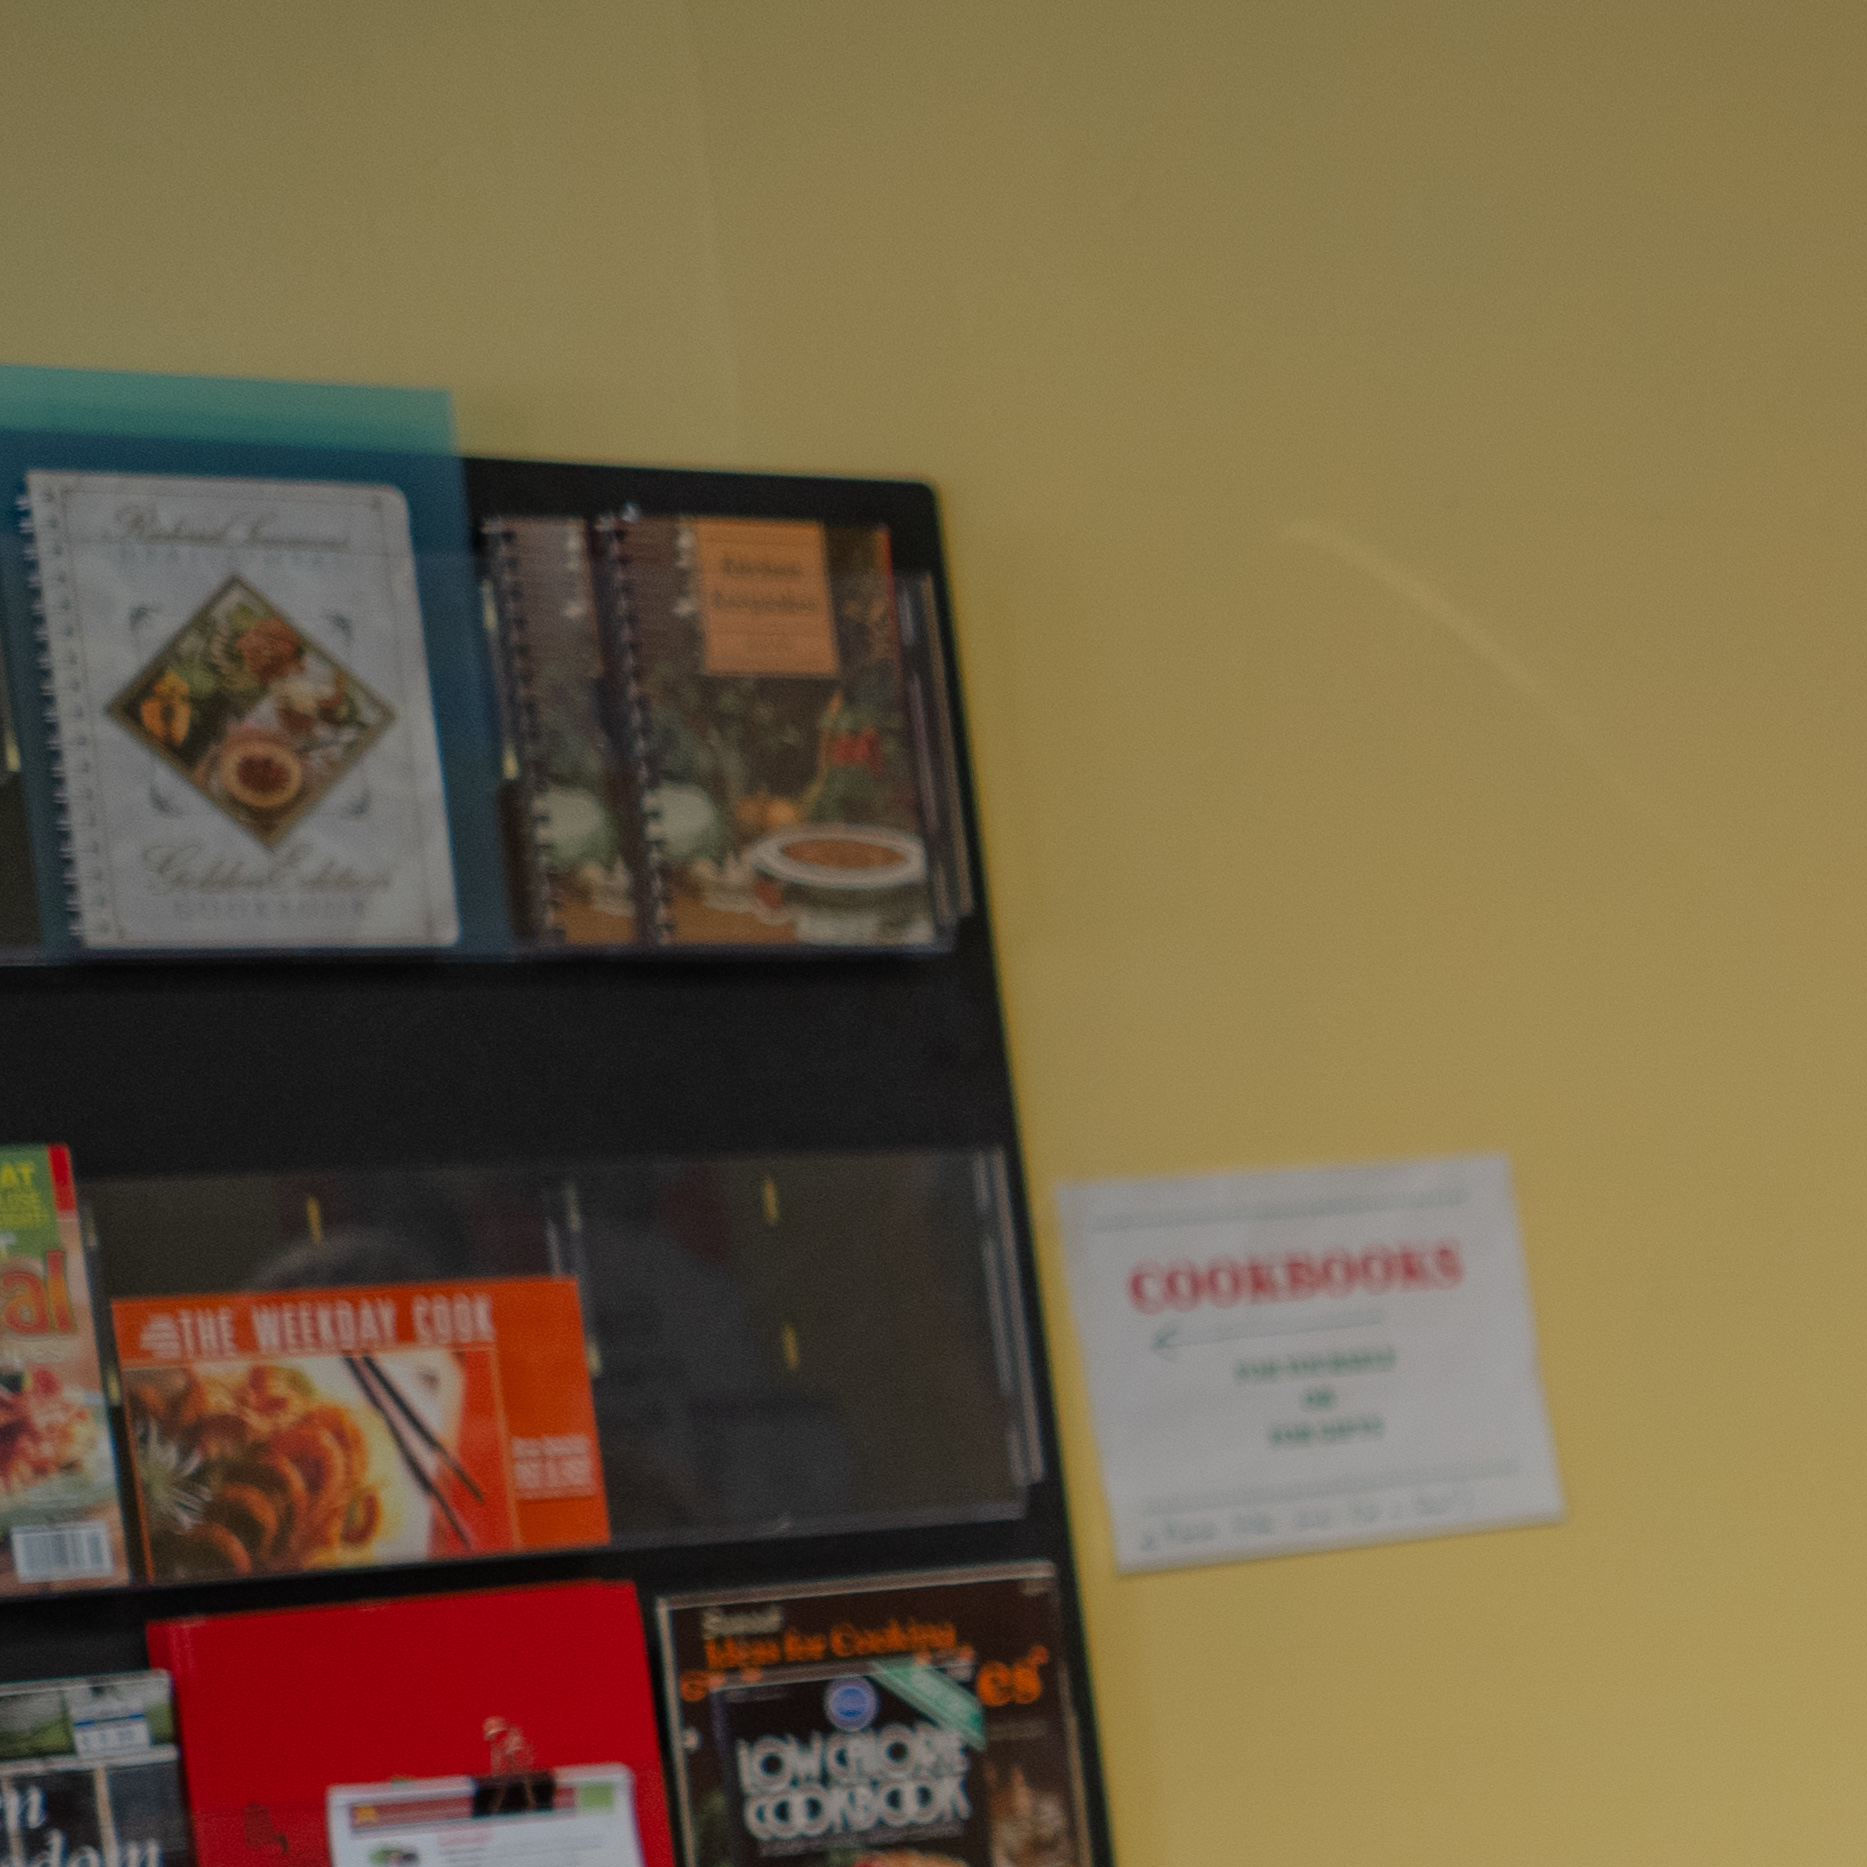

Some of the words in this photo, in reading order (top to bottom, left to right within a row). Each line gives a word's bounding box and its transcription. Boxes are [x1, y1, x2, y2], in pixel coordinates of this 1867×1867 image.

[1127, 1238, 1466, 1315] COOKBOOKS
[178, 1306, 237, 1359] THE
[250, 1297, 396, 1357] WEEKDAY
[411, 1293, 495, 1346] COOK
